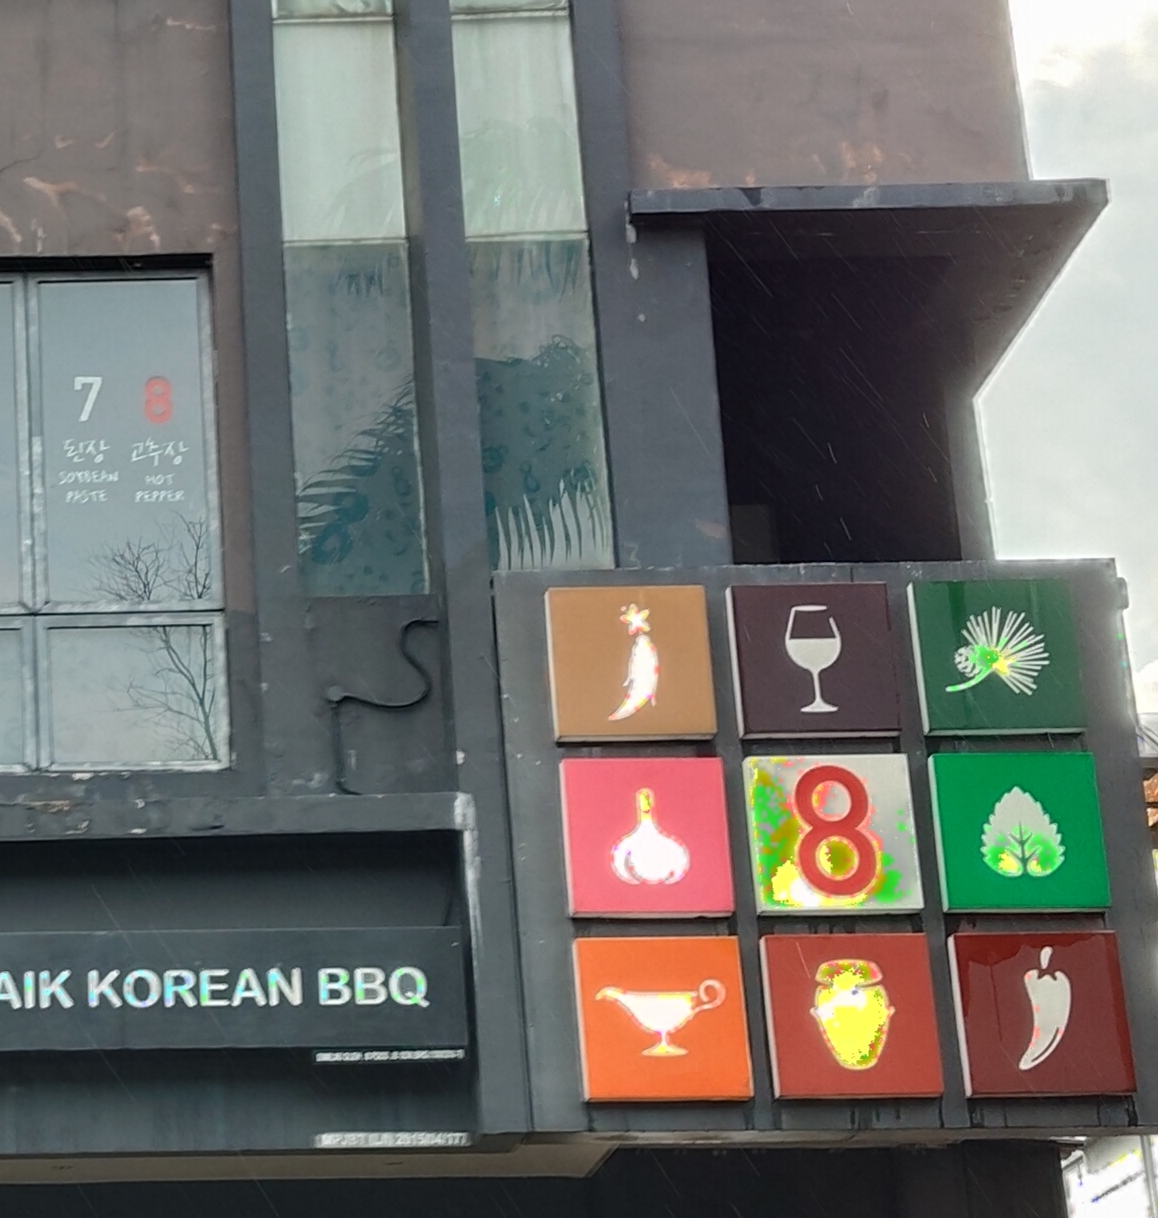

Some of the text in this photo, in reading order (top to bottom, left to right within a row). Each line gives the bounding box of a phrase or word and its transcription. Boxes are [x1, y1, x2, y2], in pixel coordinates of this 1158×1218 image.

[74, 376, 103, 422] 7
[144, 375, 173, 424] 8
[134, 489, 185, 503] PEPPER
[144, 473, 175, 485] HOT
[795, 765, 878, 897] 8
[87, 967, 303, 1010] KOREAN
[317, 966, 430, 1008] BBQ
